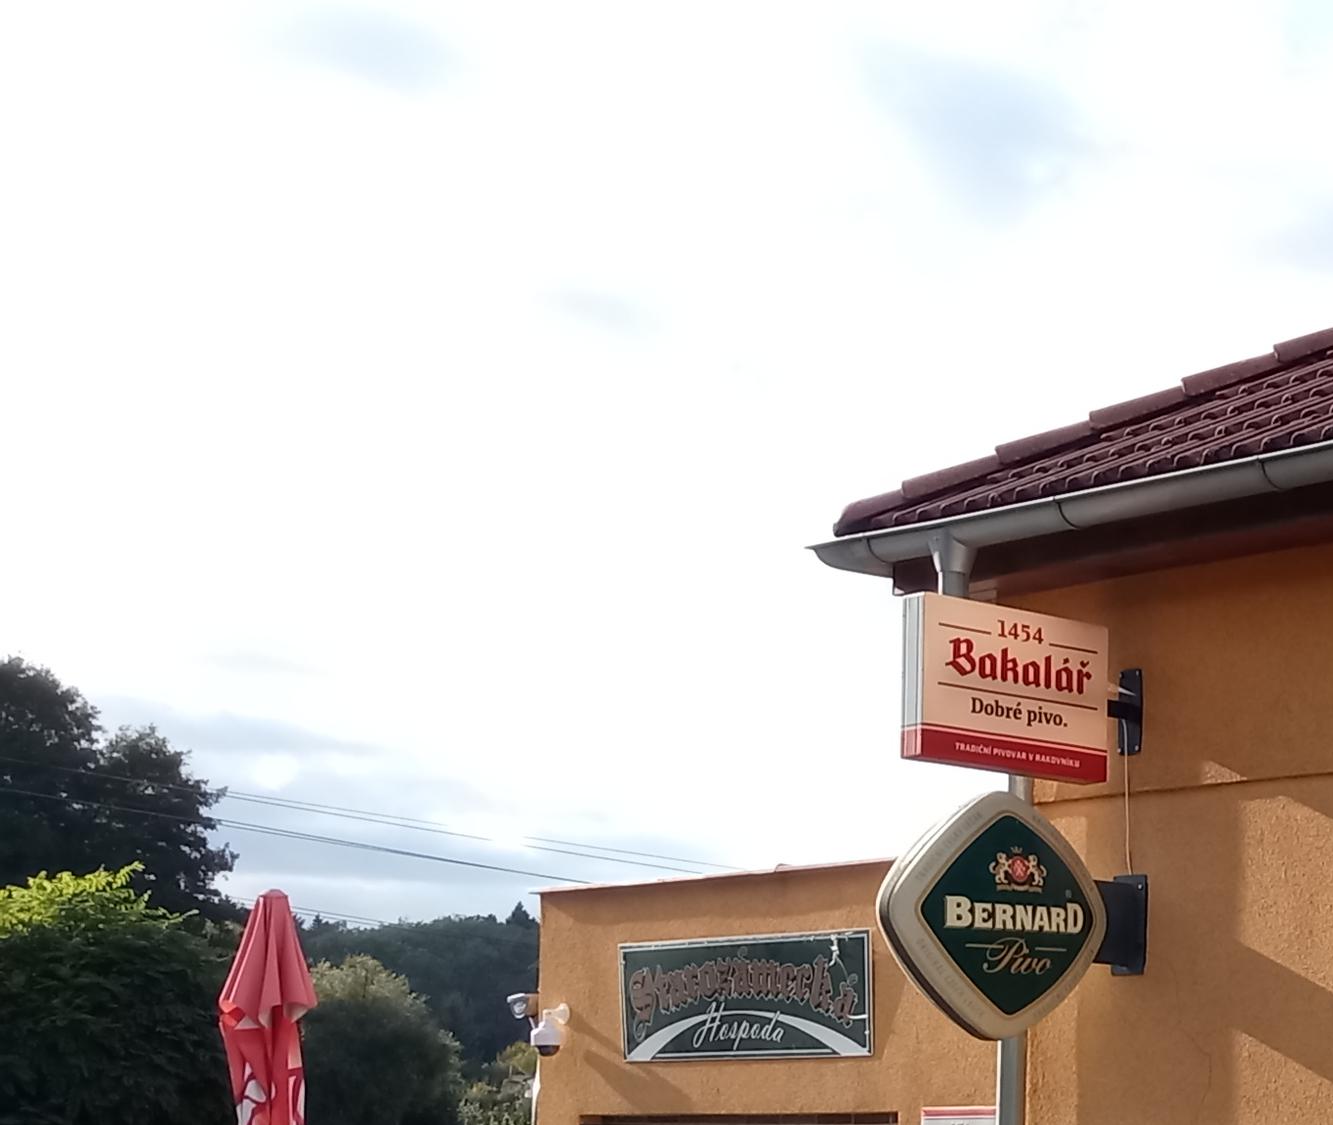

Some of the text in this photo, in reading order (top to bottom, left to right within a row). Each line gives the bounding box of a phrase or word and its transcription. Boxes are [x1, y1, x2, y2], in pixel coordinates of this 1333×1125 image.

[997, 619, 1044, 645] 1454
[944, 637, 1093, 695] Bakalář
[970, 696, 1068, 727] Dobré pivo.
[954, 741, 992, 755] TRADIČNÍ
[993, 747, 1027, 760] PIVOVAR
[1028, 753, 1034, 762] V
[943, 895, 1084, 934] BERNARD
[983, 937, 1051, 975] Pivo
[693, 1001, 785, 1052] Hospoda
